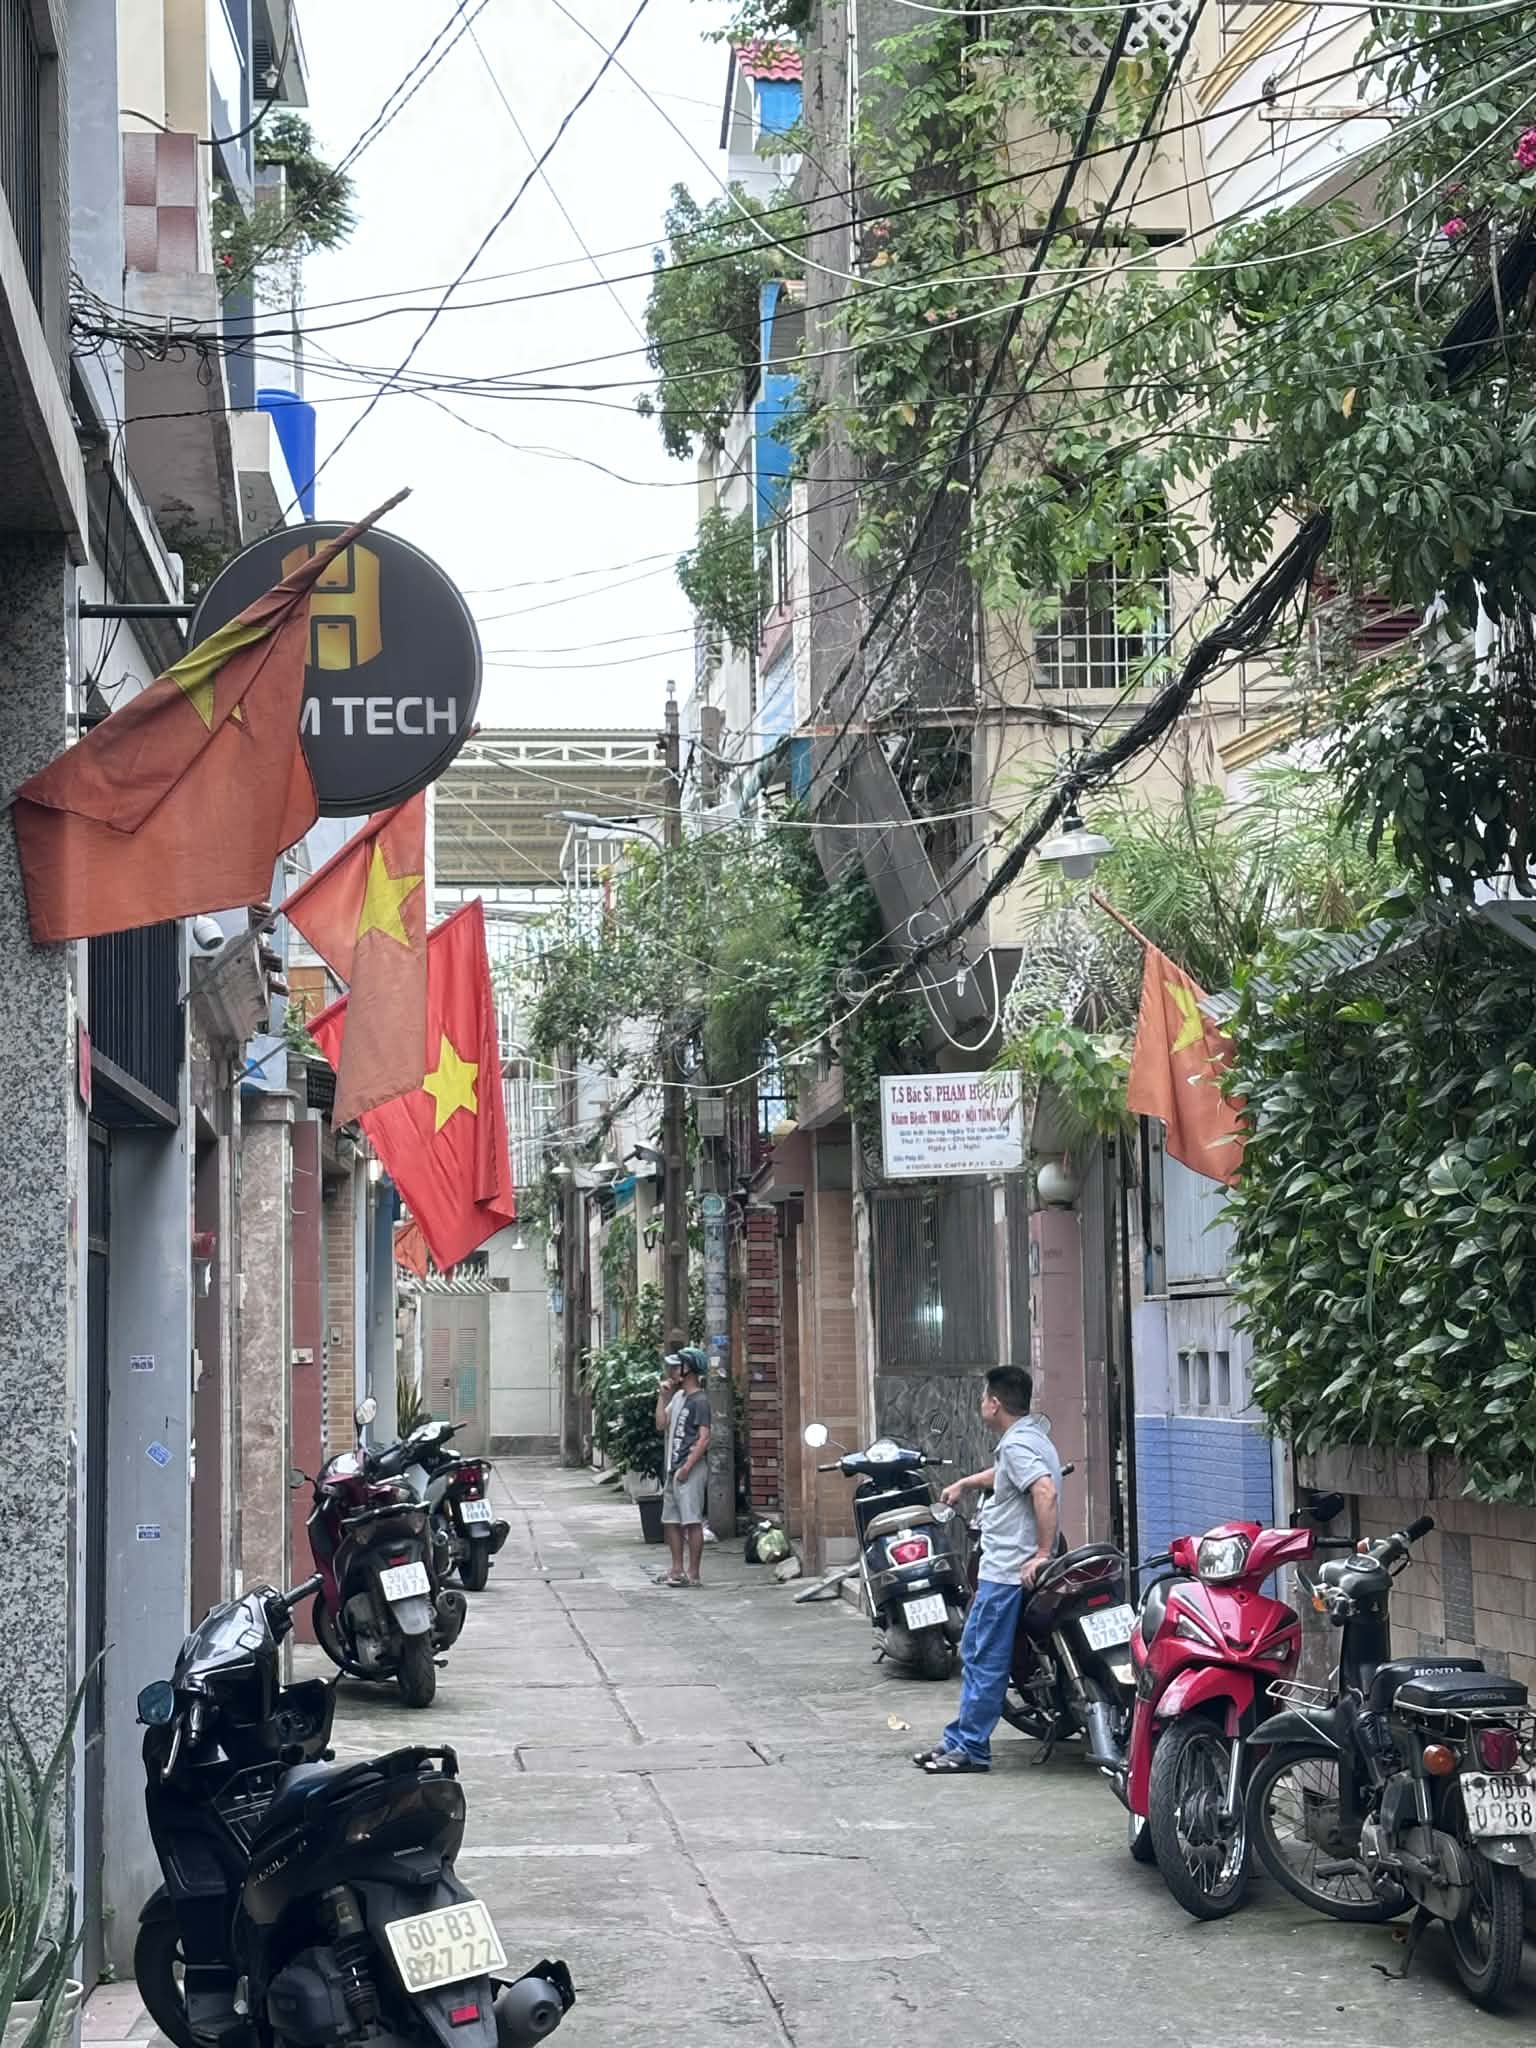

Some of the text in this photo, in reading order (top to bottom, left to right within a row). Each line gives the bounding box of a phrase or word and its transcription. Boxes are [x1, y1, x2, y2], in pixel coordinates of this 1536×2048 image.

[332, 697, 456, 735] TECH
[936, 1084, 966, 1104] PHẠM
[1414, 1666, 1463, 1677] HONDA
[405, 1911, 477, 1950] 60-B3
